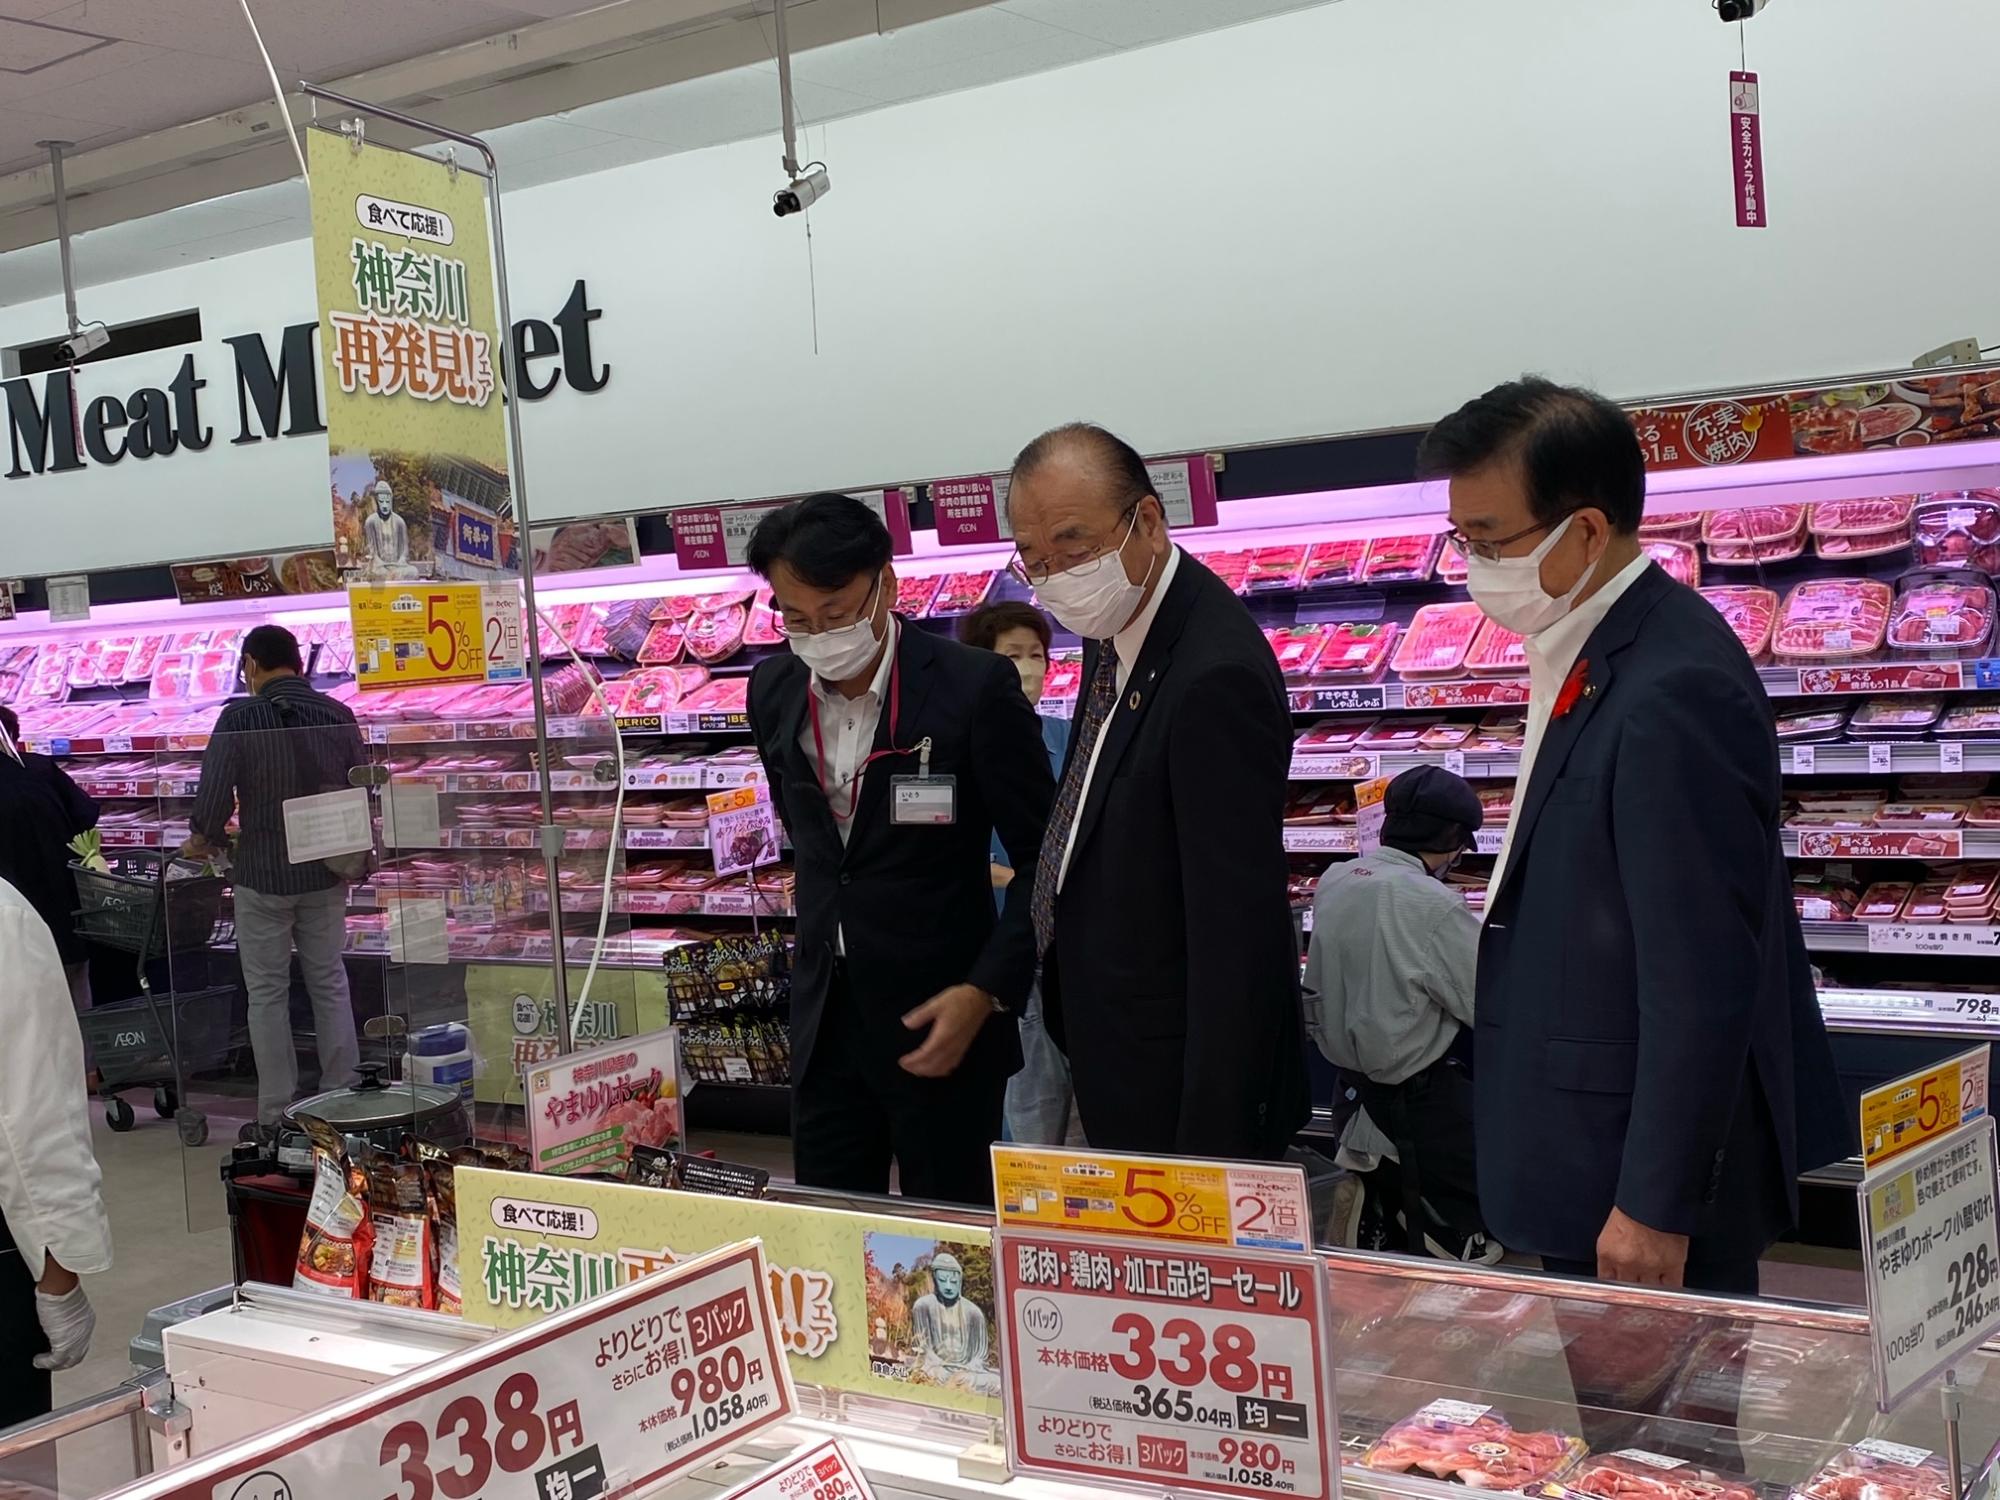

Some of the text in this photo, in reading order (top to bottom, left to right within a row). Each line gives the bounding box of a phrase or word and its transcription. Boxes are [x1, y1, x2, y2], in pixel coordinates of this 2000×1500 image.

[367, 202, 444, 237] 食べて応援!
[352, 242, 466, 322] 神奈川
[333, 316, 477, 400] 再発見!
[474, 336, 492, 402] フェア
[2, 353, 213, 478] Meat
[222, 278, 610, 445] Met
[1690, 405, 1741, 441] 充実
[1705, 430, 1750, 463] 焼肉
[457, 648, 483, 671] OFF
[1840, 837, 1871, 847] 選べる
[1892, 931, 1972, 941] 牛タン塩焼き用
[1955, 998, 1999, 1015] 798円
[544, 1068, 664, 1129] やまゆりポーク
[1940, 1104, 1960, 1125] OFF
[502, 1203, 584, 1232] 食べて応援!
[1177, 1214, 1226, 1234] OFF
[1235, 1195, 1298, 1233] 2倍
[1878, 1193, 1994, 1280] やまゆりポーク小間切れ
[483, 1239, 617, 1310] 神奈川
[1016, 1243, 1300, 1309] 豚肉・鶏肉・加工品均一セール
[692, 1297, 746, 1348] 3パック
[806, 1277, 834, 1351] フェア
[595, 1305, 682, 1369] よりどりで
[611, 1336, 688, 1392] さらにお得!
[1037, 1414, 1113, 1442] よりどりで
[1243, 1402, 1300, 1429] 均一
[1054, 1441, 1133, 1466] さらにお得!
[1140, 1442, 1186, 1467] 3パック
[778, 1464, 815, 1493] よりどりで
